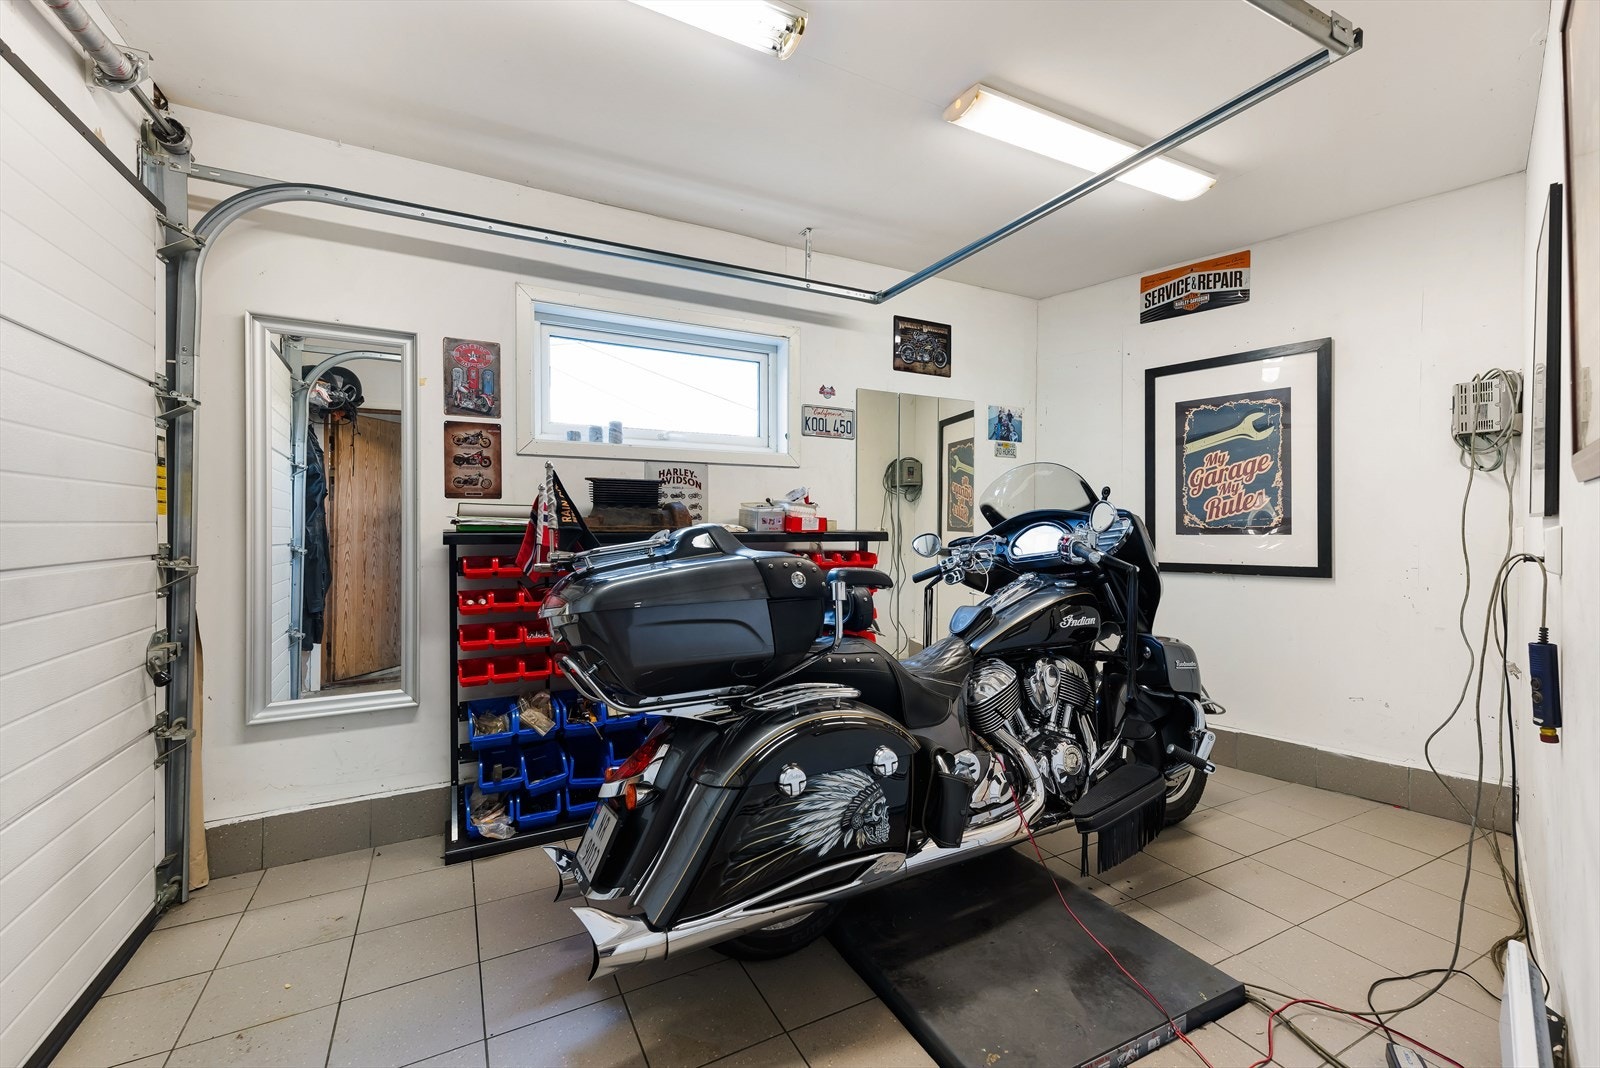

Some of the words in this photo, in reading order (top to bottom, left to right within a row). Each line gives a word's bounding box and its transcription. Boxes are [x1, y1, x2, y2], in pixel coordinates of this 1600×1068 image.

[1144, 276, 1191, 309] SERVICE
[1191, 276, 1197, 290] &
[1197, 270, 1243, 291] REPAIR
[805, 416, 831, 433] KOOL
[833, 419, 853, 435] 450
[1204, 450, 1230, 467] My
[658, 468, 698, 479] HARLEY-
[1188, 454, 1273, 497] Garage
[660, 476, 702, 490] AVIDSON
[1218, 480, 1245, 496] My
[1204, 489, 1271, 522] Rules
[1059, 614, 1096, 629] Indian
